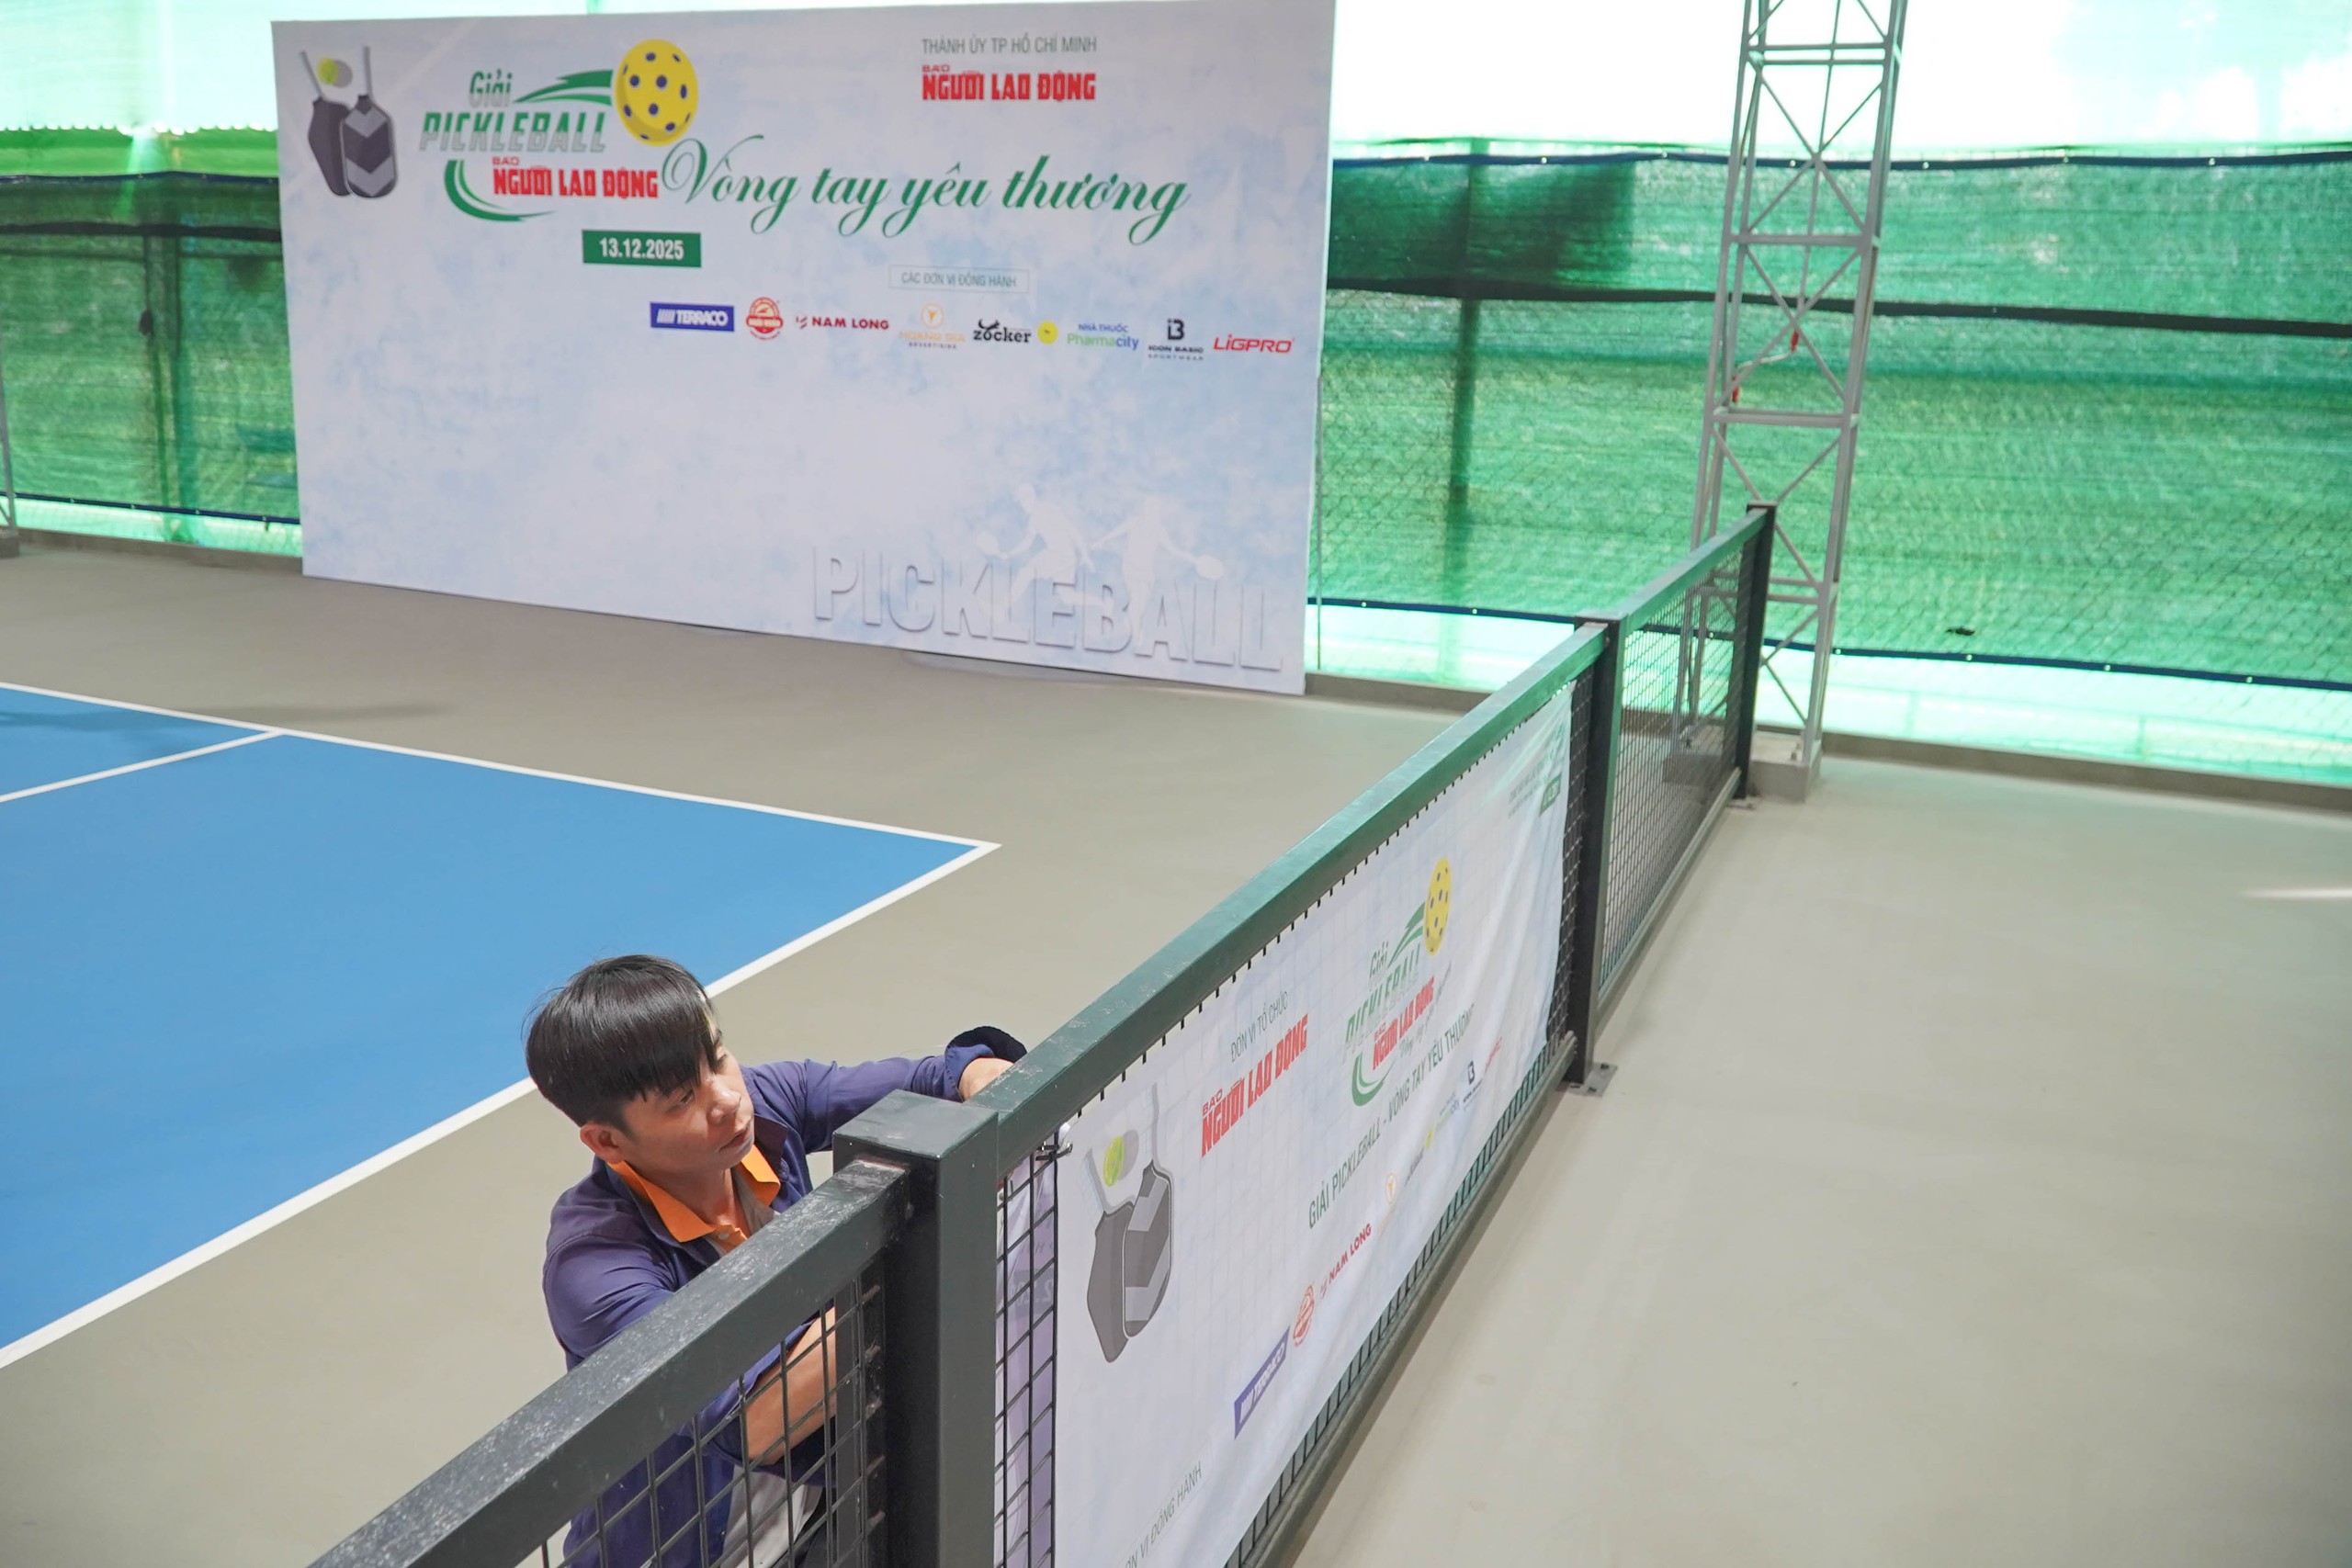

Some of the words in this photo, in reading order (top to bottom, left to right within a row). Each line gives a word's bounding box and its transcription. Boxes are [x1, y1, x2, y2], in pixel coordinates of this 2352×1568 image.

[922, 36, 965, 55] THÀNH
[969, 33, 988, 54] ỦY
[991, 38, 1008, 54] TP
[1012, 32, 1031, 53] HỒ
[1035, 34, 1057, 53] CHÍ
[1061, 37, 1098, 53] MINH
[468, 67, 513, 108] Giải
[990, 73, 1032, 101] LAO
[1036, 70, 1096, 102] ĐỘNG
[418, 111, 606, 152] PICKLEBALL
[559, 168, 596, 197] LAO
[602, 166, 659, 199] ĐỘNG
[662, 134, 799, 235] Vòng
[811, 167, 889, 238] tay
[882, 162, 993, 239] yêu
[1002, 154, 1192, 246] thương
[599, 237, 684, 261] 13.12.2025
[900, 271, 920, 284] CÁC
[811, 316, 847, 328] NAM
[851, 317, 889, 330] LONG
[1067, 333, 1139, 351] Pharmacity
[812, 547, 1283, 672] PICKLEBALL
[1230, 1031, 1248, 1063] ĐƠN
[1257, 1002, 1268, 1036] TỔ
[1248, 1049, 1273, 1110] LAO
[1275, 1013, 1309, 1079] ĐỘNG
[1308, 1179, 1329, 1229] GIẢI
[1332, 1116, 1382, 1201] PICKLEBALL
[1388, 1087, 1410, 1122] VÒNG
[1412, 1055, 1426, 1092] TAY
[1428, 1037, 1443, 1072] YÊU
[1329, 1250, 1349, 1286] NAM
[1350, 1223, 1372, 1257] LONG
[1150, 1497, 1175, 1544] ĐỒNG
[1177, 1461, 1202, 1507] HÀNH
